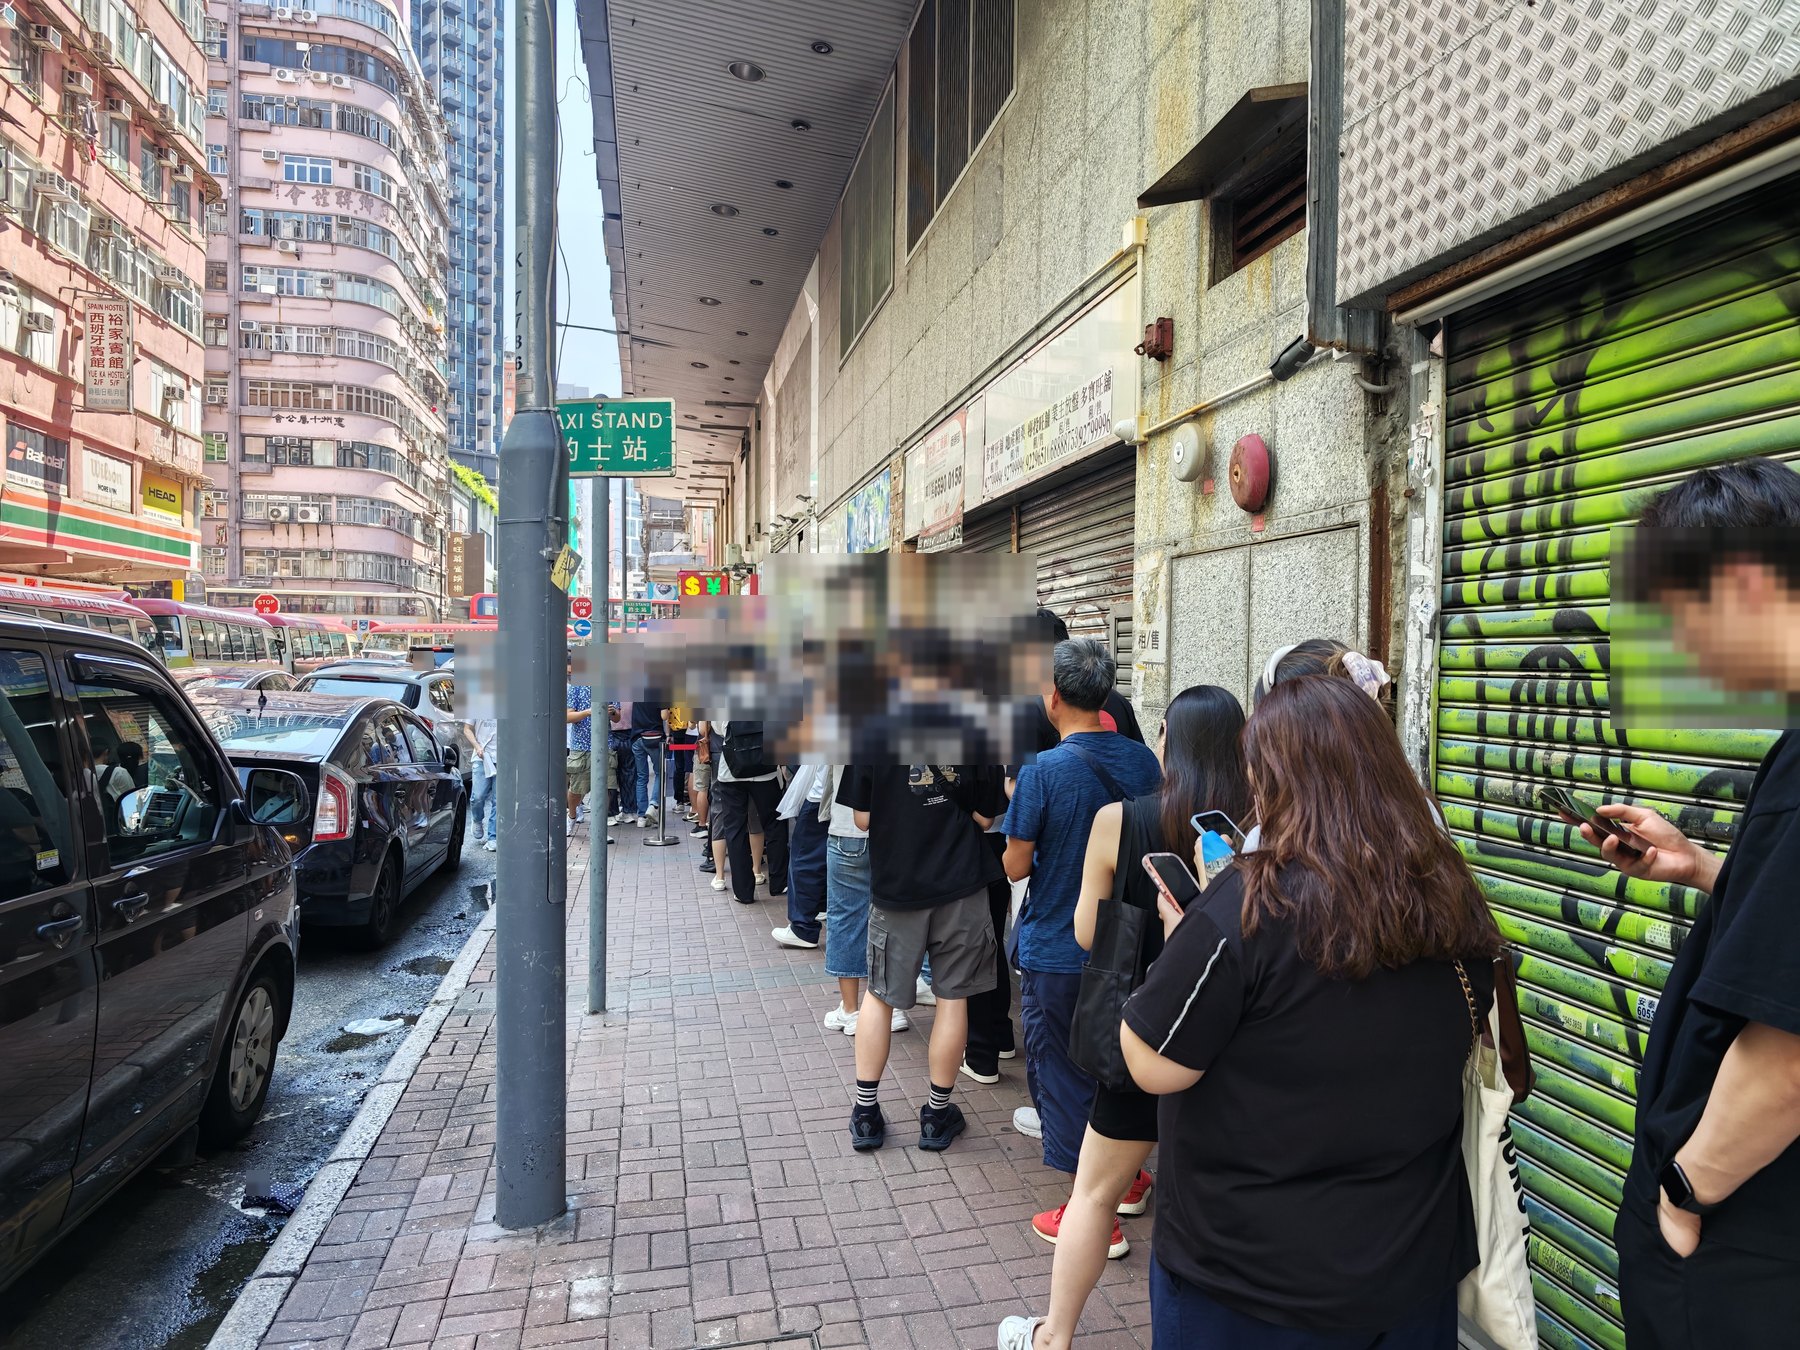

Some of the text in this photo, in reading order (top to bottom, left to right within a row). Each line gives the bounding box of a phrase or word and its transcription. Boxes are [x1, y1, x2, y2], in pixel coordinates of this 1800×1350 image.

[90, 312, 105, 368] 西班牙賓館
[108, 314, 124, 369] 裕家賓館
[108, 371, 125, 379] HOSTEL
[1081, 370, 1112, 408] 多寶旺舖
[557, 413, 662, 429] AXI STAND
[91, 458, 122, 485] Wilson
[149, 487, 176, 503] HEAD
[1138, 630, 1159, 650] 租/售
